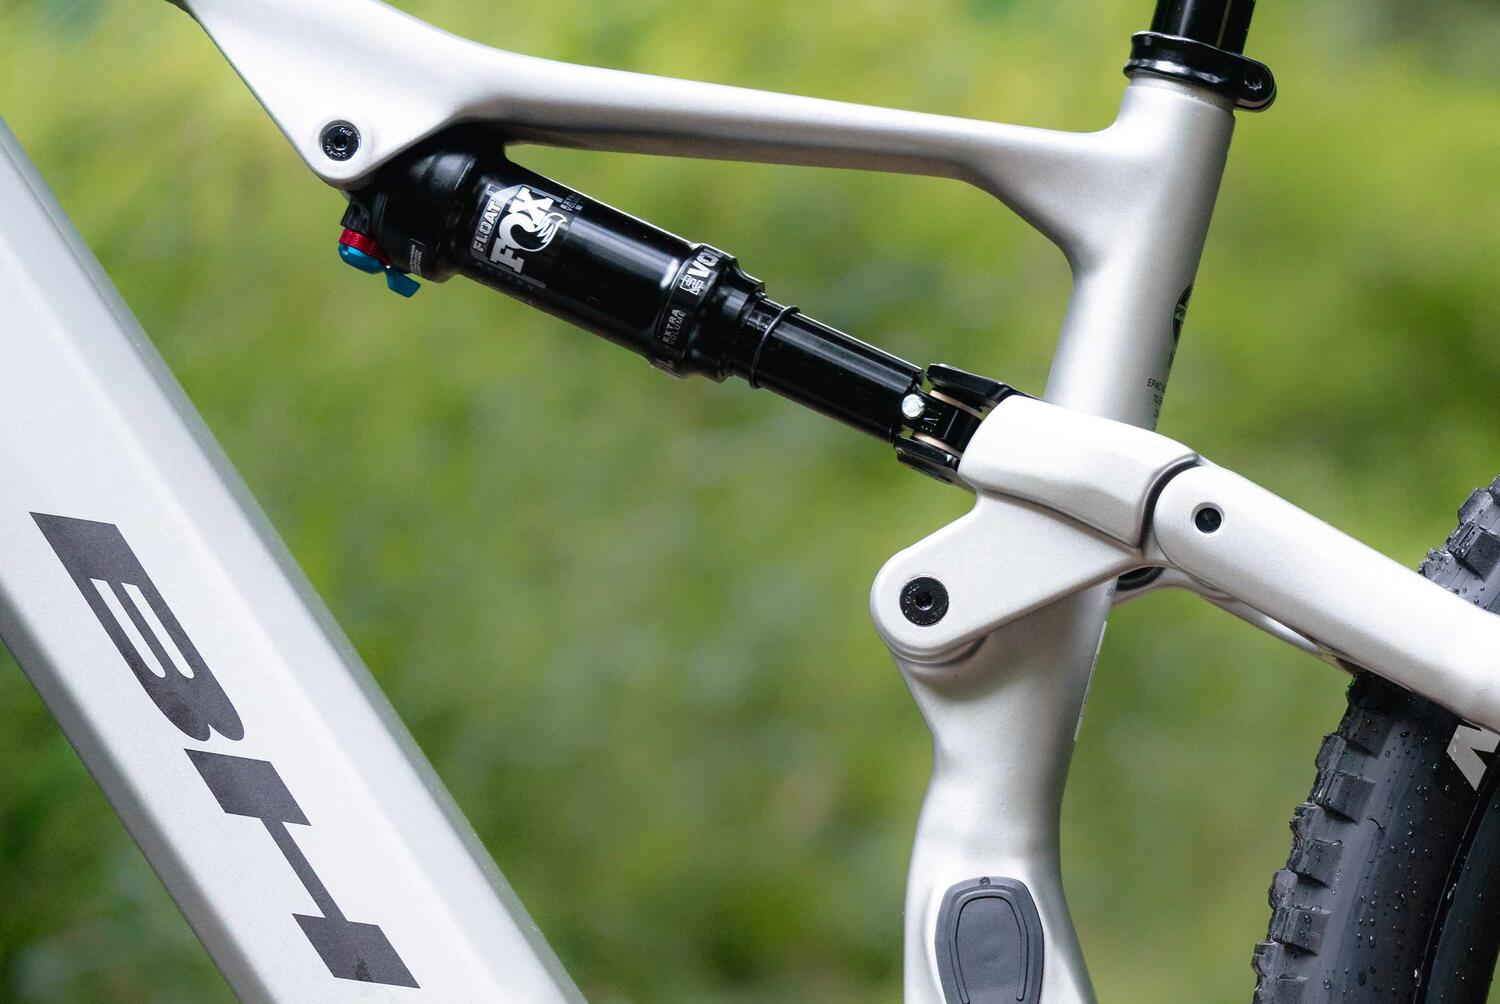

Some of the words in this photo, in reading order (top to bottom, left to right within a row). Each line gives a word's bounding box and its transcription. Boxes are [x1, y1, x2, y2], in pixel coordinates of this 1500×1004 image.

[472, 200, 501, 253] FLOAT
[489, 186, 567, 274] FOX
[662, 308, 681, 343] EXTRA
[669, 311, 686, 346] VOLUME
[29, 511, 421, 989] BH
